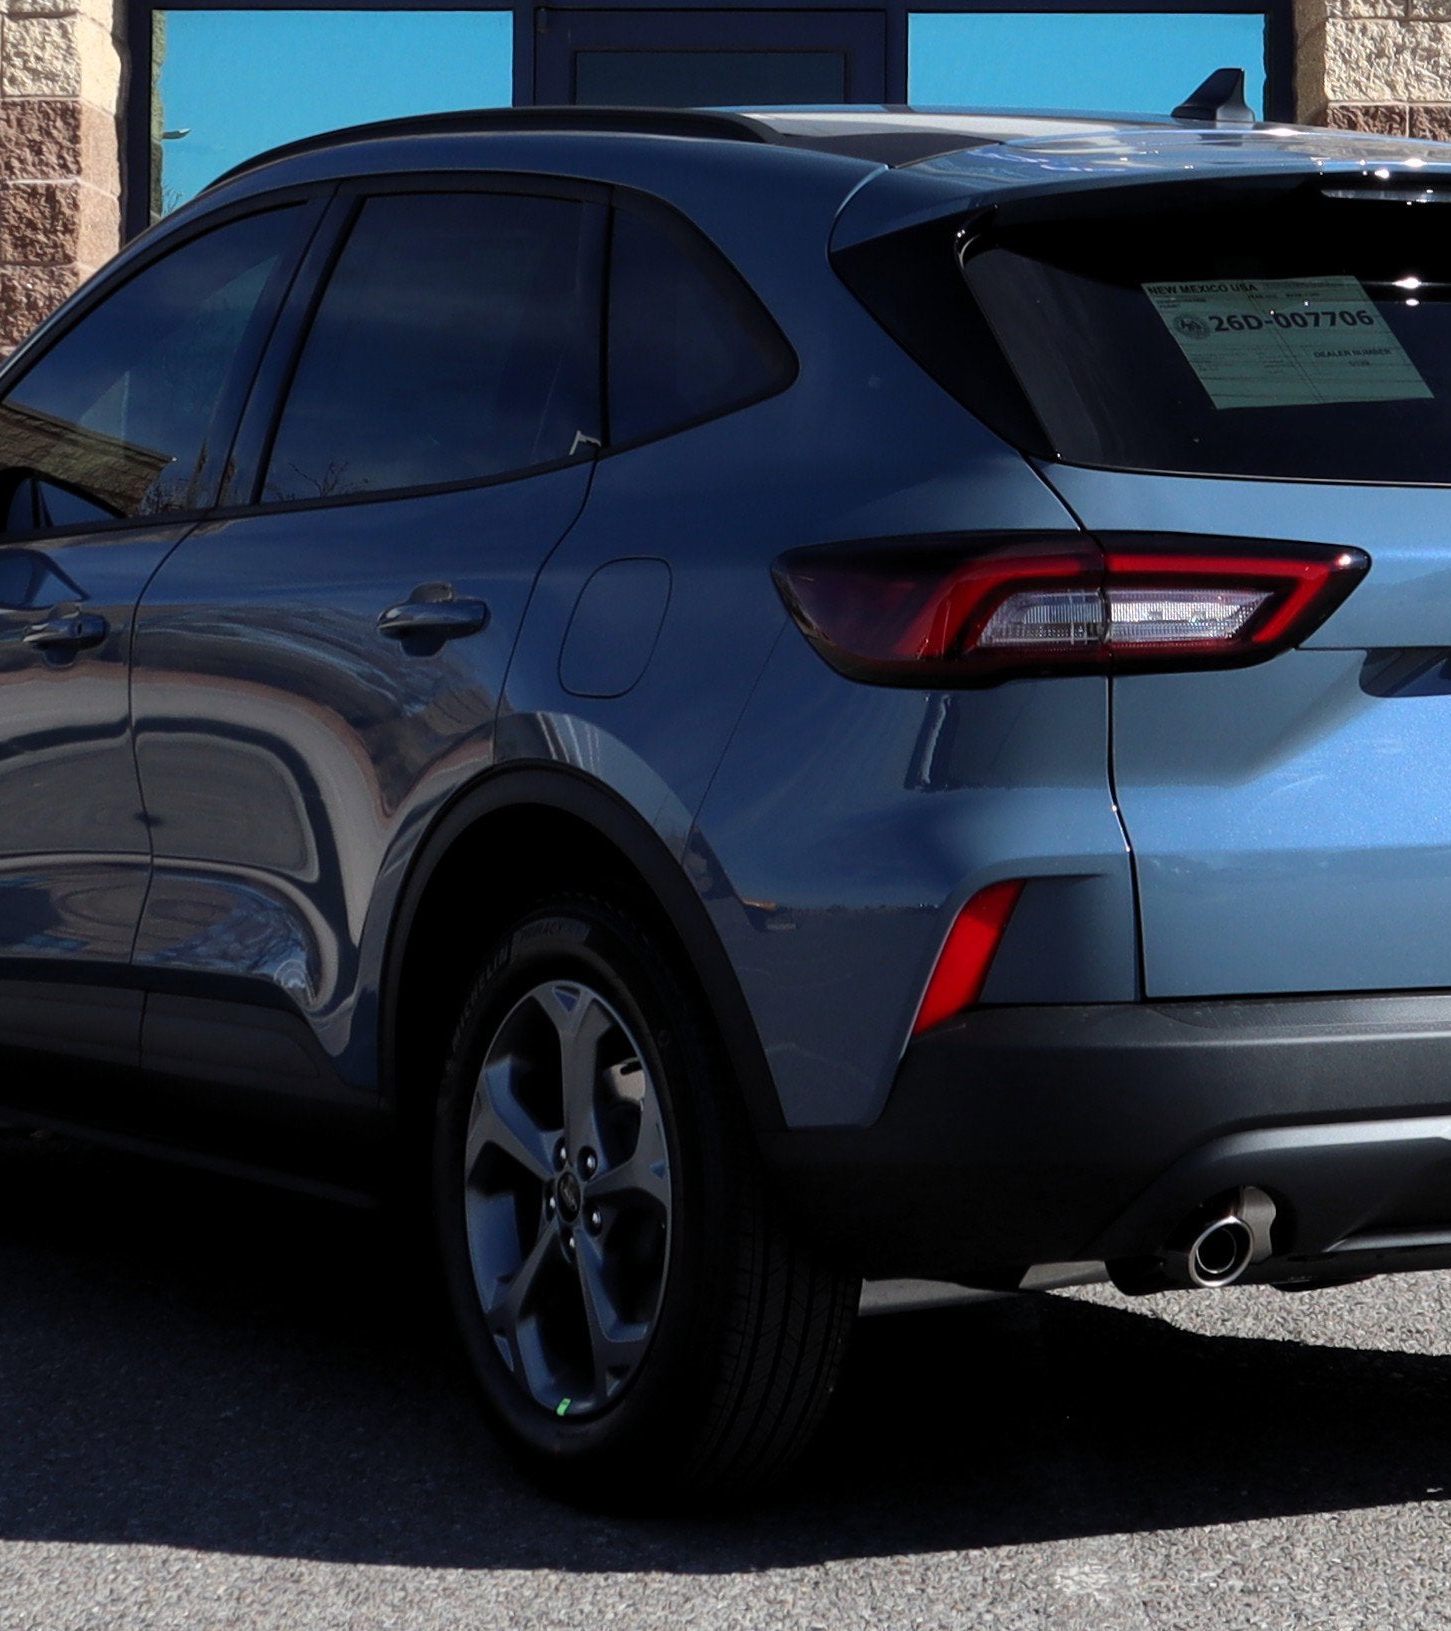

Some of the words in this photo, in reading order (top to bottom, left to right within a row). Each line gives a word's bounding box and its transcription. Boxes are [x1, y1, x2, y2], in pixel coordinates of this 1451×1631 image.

[1148, 285, 1177, 296] NEW
[1179, 283, 1228, 294] MEXICO
[1229, 282, 1258, 293] USA
[1208, 310, 1374, 333] 26D-007706
